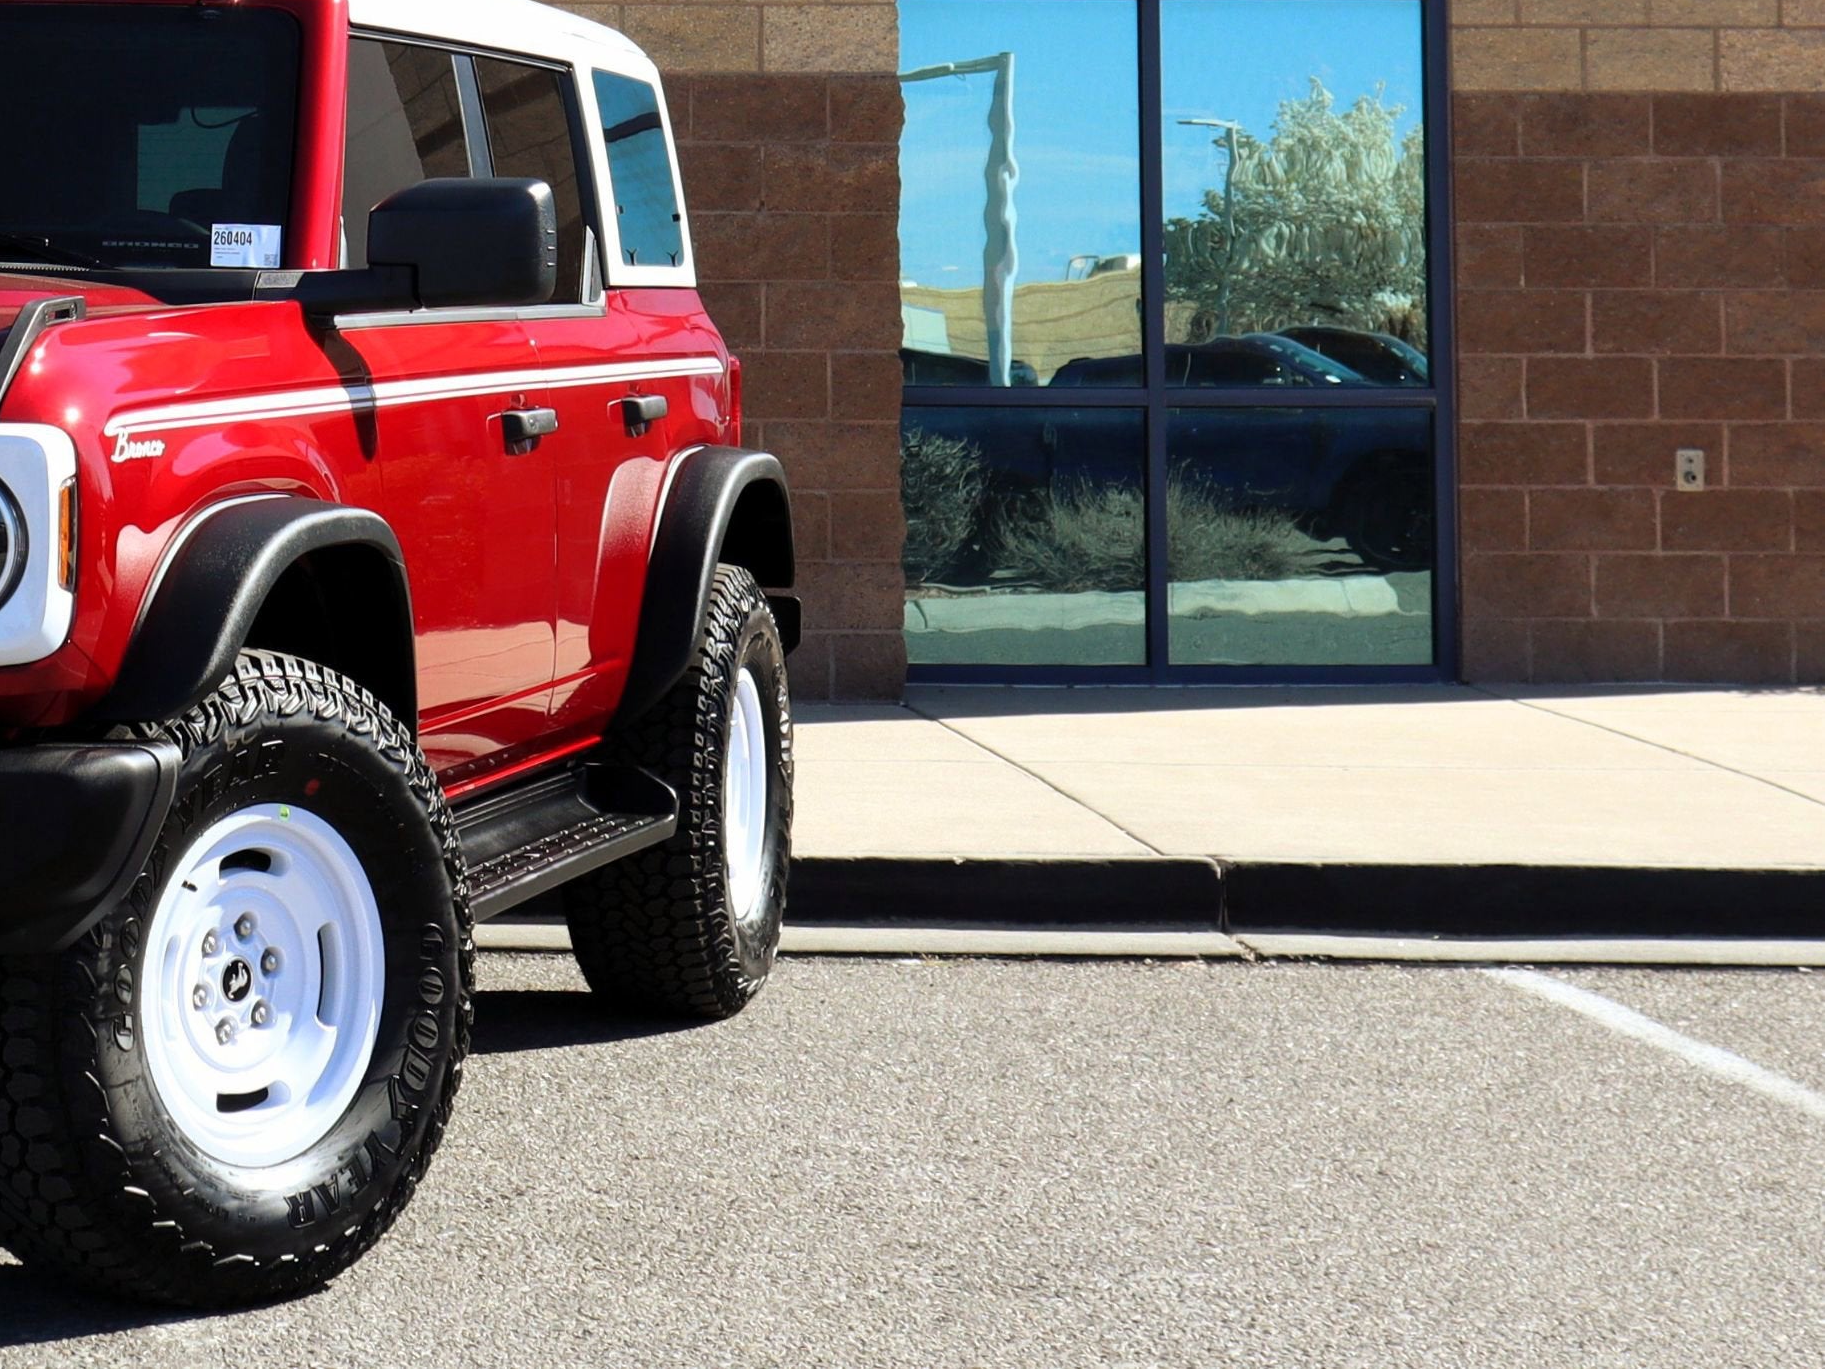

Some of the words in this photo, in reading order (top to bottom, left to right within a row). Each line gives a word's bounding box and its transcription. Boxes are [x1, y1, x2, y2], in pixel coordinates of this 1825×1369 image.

[213, 231, 253, 246] 260404
[111, 429, 166, 463] Bronco
[282, 922, 447, 1229] GOODYEAR
